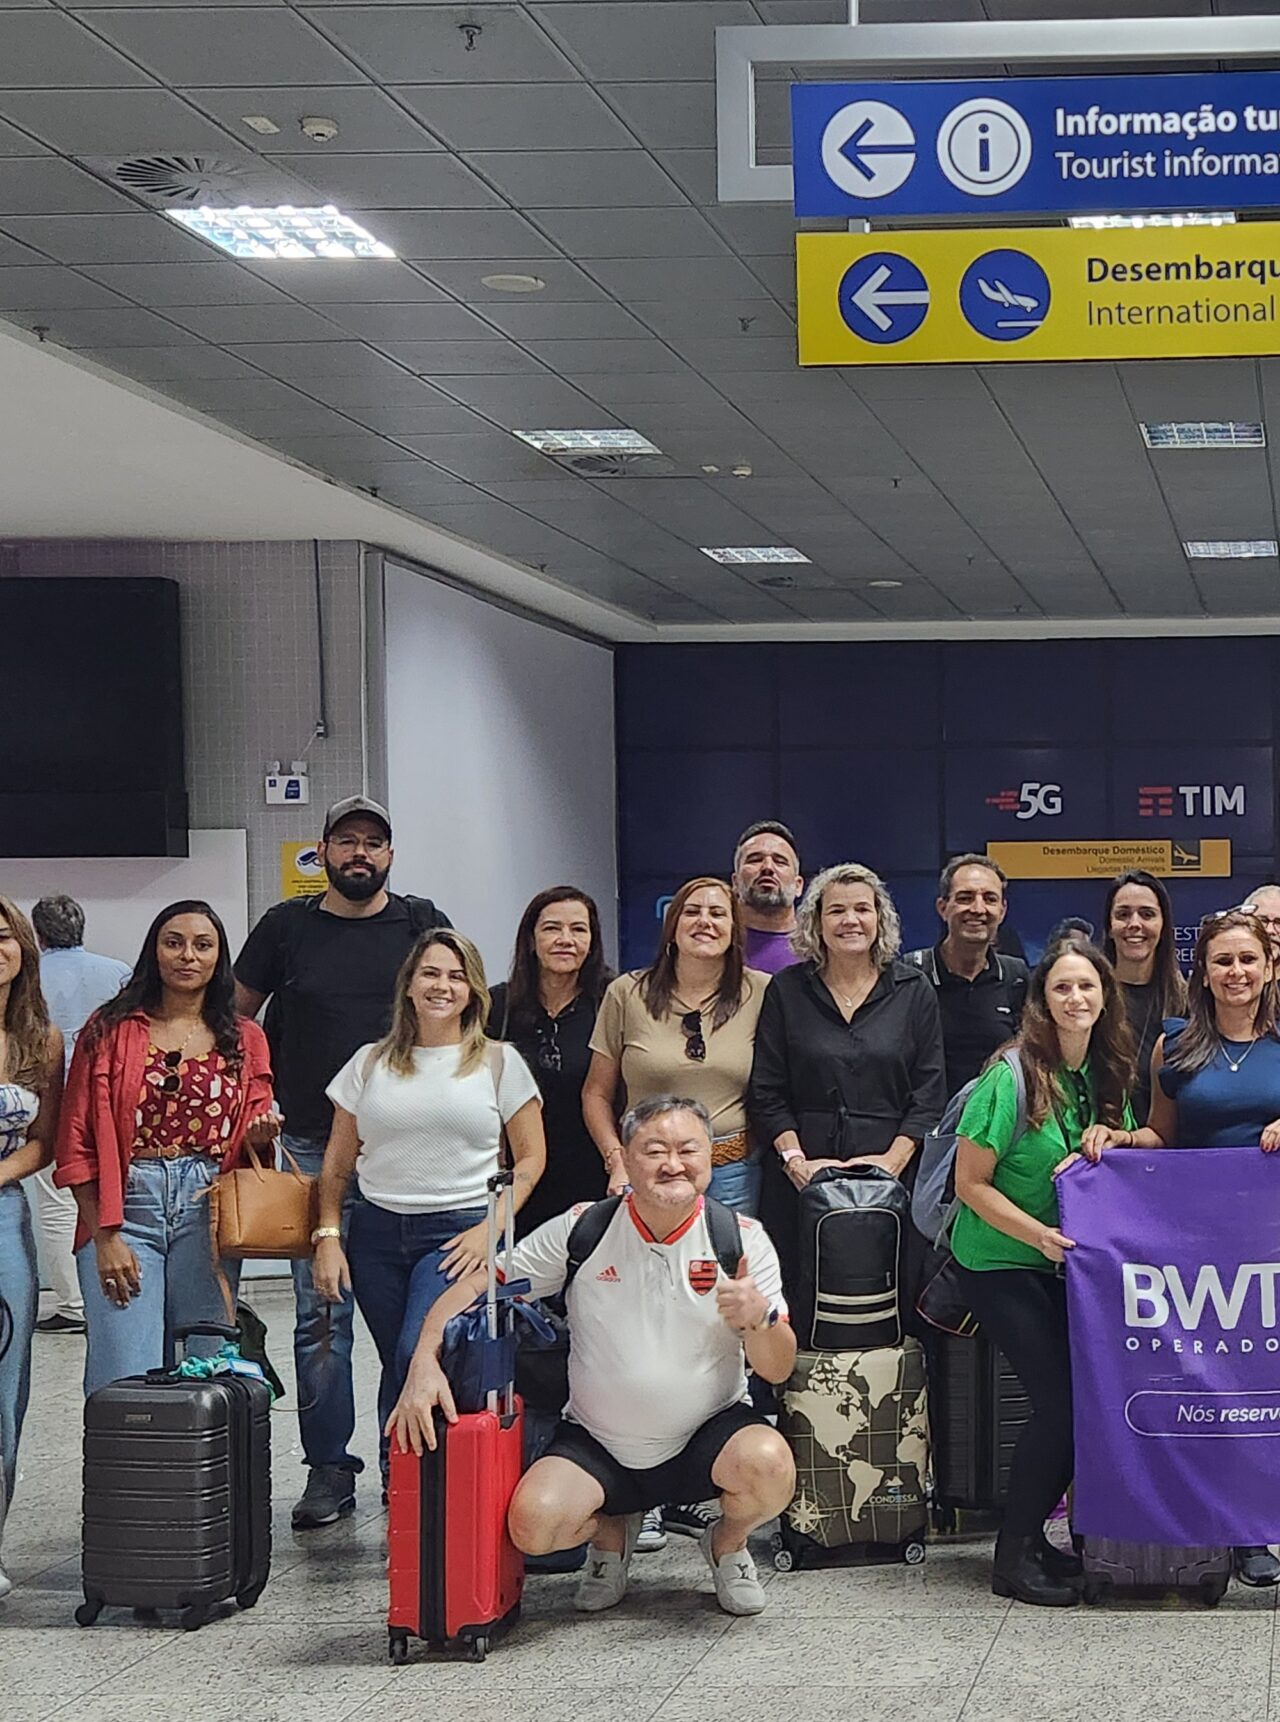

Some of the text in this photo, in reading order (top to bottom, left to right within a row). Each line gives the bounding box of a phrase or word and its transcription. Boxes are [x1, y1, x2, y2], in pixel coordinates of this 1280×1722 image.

[1055, 104, 1238, 140] Informação
[1054, 150, 1157, 179] Tourist
[1087, 294, 1276, 326] International
[1016, 782, 1063, 819] 5G
[1178, 785, 1245, 816] TIM
[1042, 845, 1165, 856] Desembarque Doméstico
[1099, 856, 1134, 864] Domestic
[1172, 926, 1204, 941] EST
[1176, 1403, 1215, 1424] Nós
